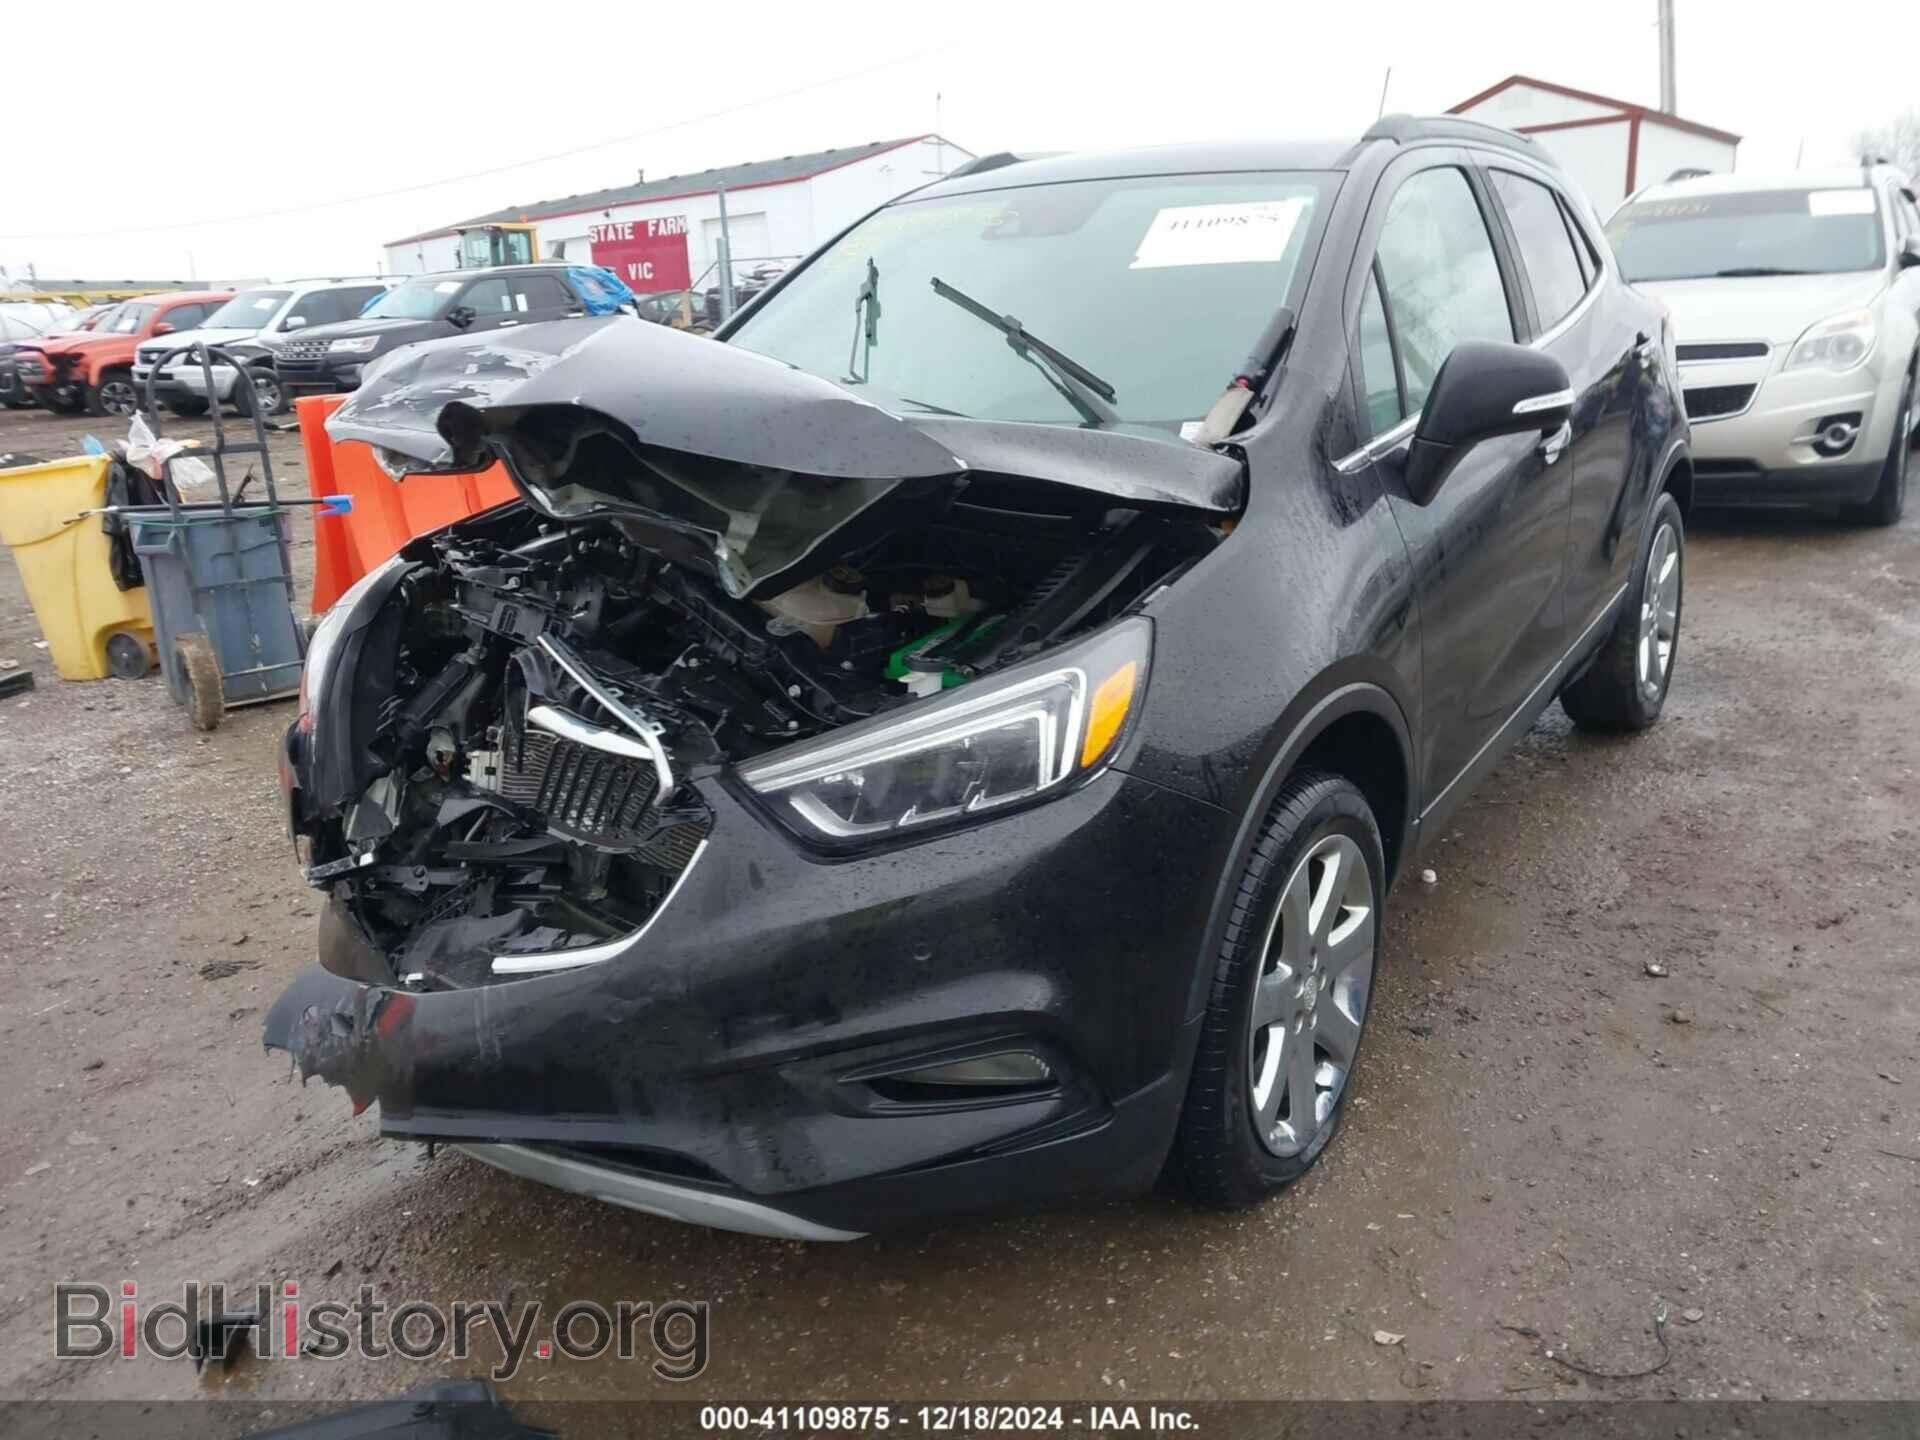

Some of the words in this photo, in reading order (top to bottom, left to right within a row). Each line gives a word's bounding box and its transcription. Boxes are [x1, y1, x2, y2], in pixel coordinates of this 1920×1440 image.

[589, 222, 634, 244] STATE
[647, 216, 689, 238] FARM
[627, 262, 654, 281] VIC
